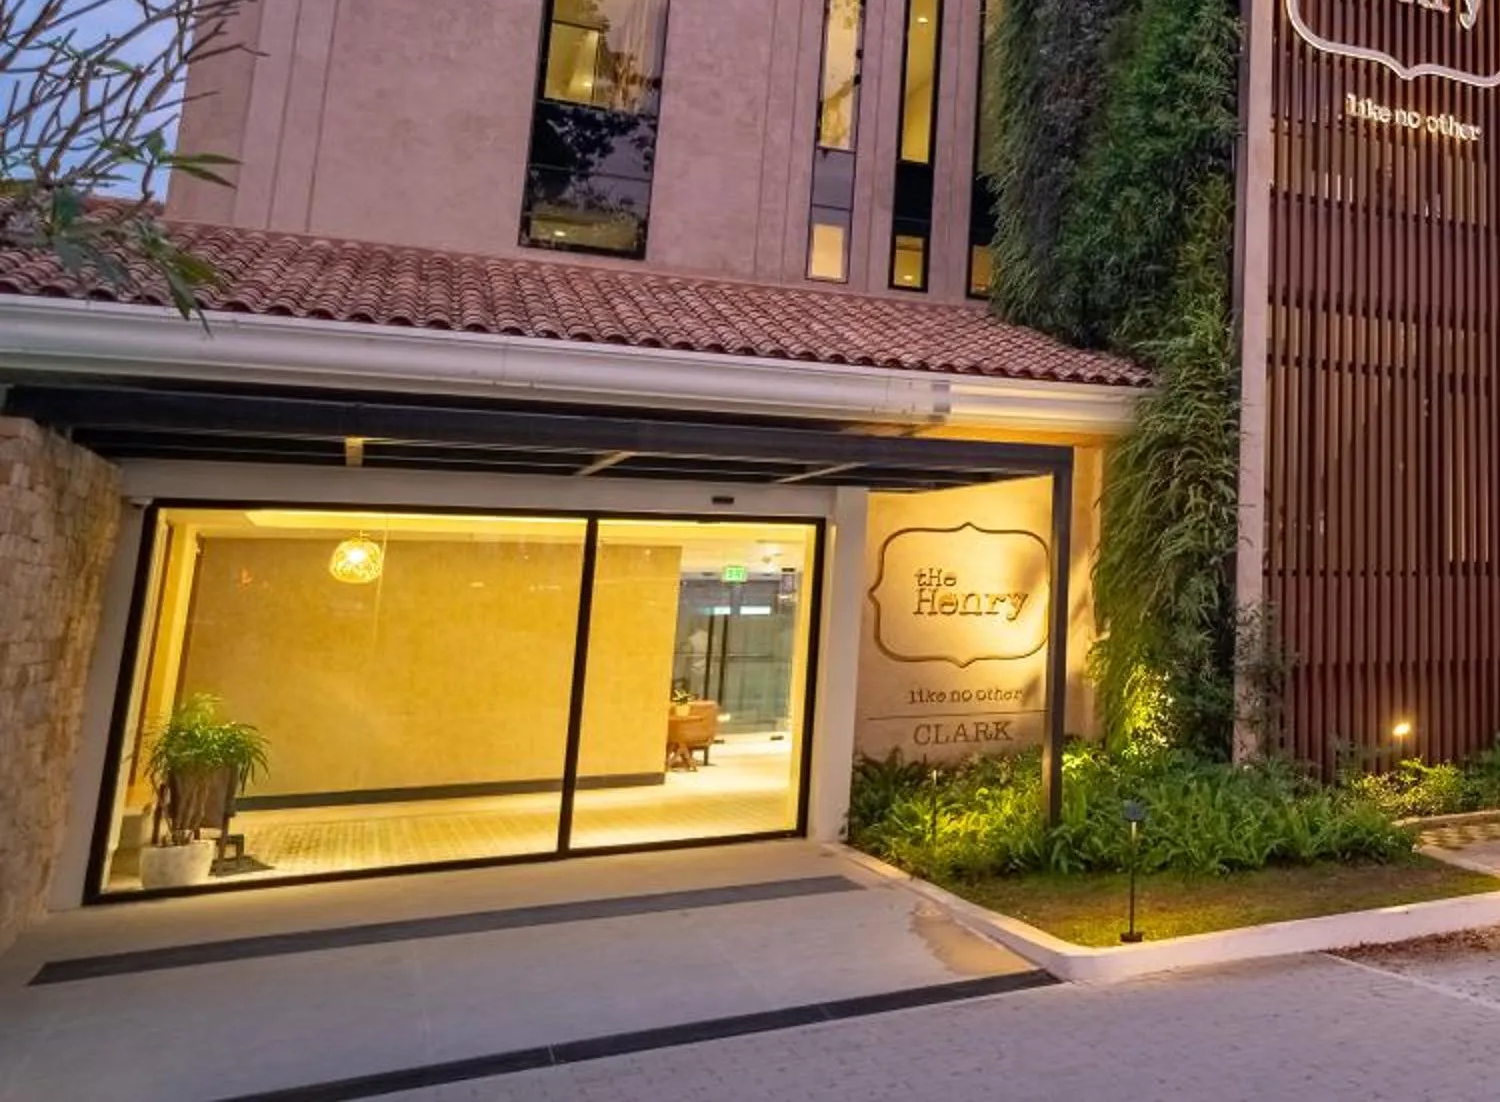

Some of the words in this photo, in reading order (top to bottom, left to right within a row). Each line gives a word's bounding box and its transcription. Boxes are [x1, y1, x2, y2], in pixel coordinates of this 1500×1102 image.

[1346, 93, 1391, 123] like
[1395, 109, 1421, 129] no
[1426, 114, 1481, 141] other
[912, 588, 1029, 621] Henry
[909, 687, 946, 704] like
[950, 689, 973, 703] no
[975, 686, 1023, 702] other
[913, 721, 1013, 746] CLARK
